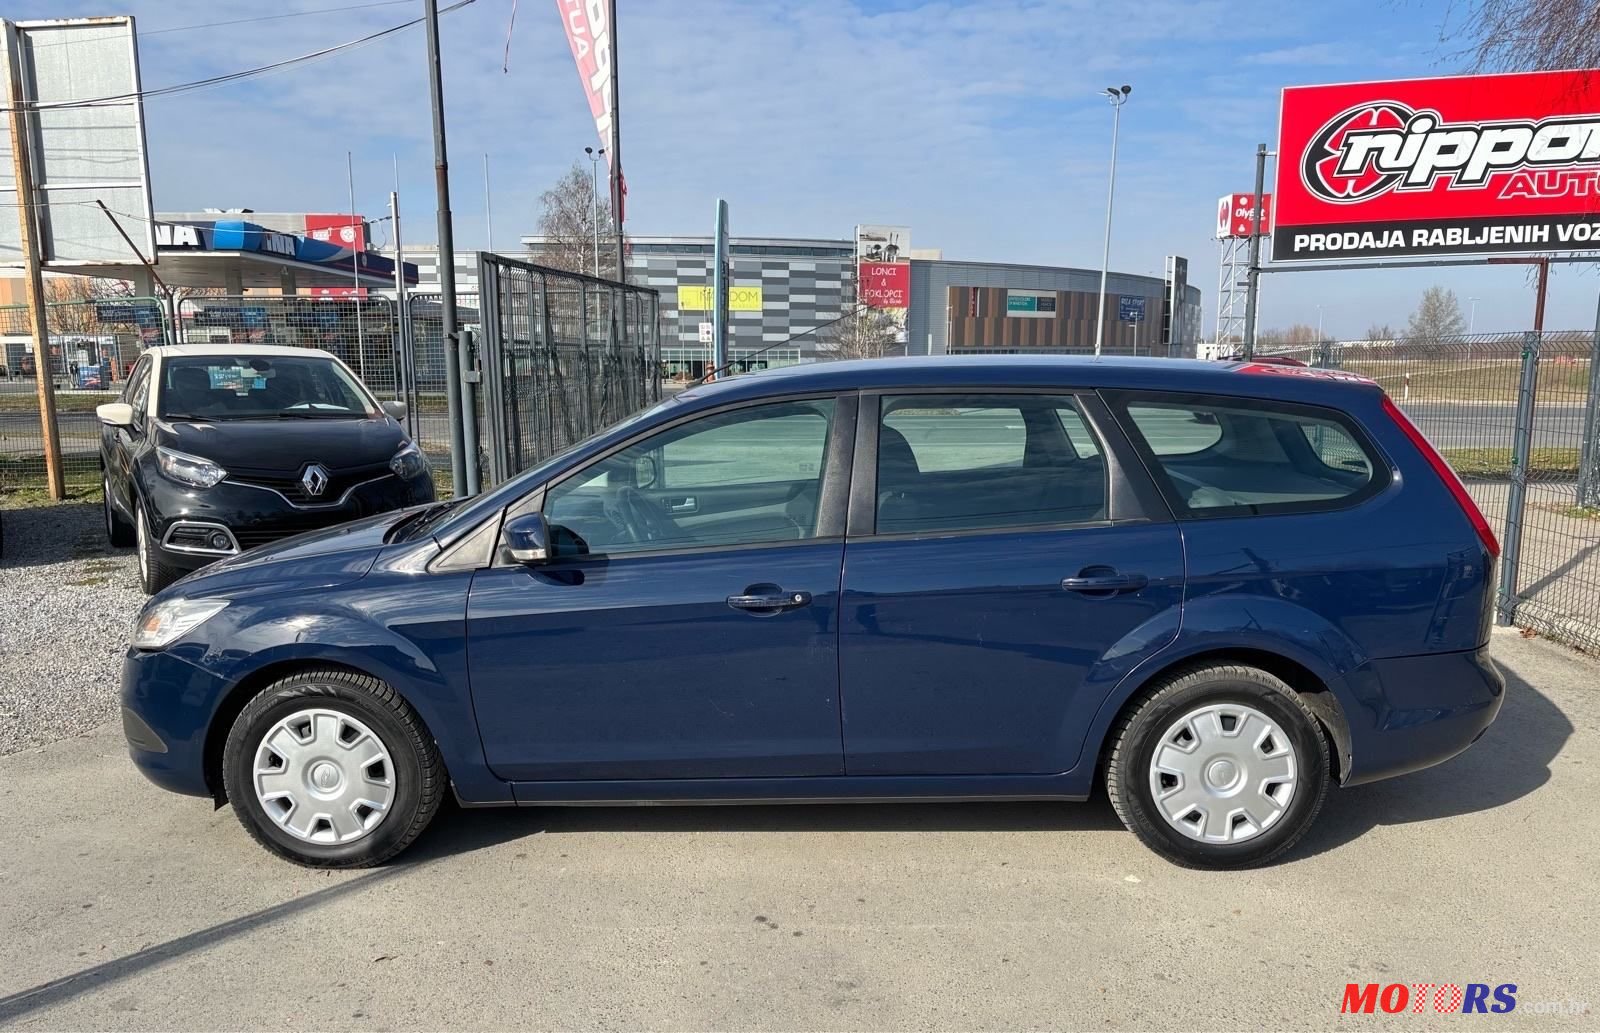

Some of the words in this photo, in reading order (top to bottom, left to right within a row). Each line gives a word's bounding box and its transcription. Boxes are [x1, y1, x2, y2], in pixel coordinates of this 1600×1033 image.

[154, 225, 200, 246] NA
[1294, 230, 1405, 251] PRODAJA
[1412, 225, 1549, 246] RABLJENIH
[871, 267, 897, 276] LONCI
[880, 278, 887, 286] &
